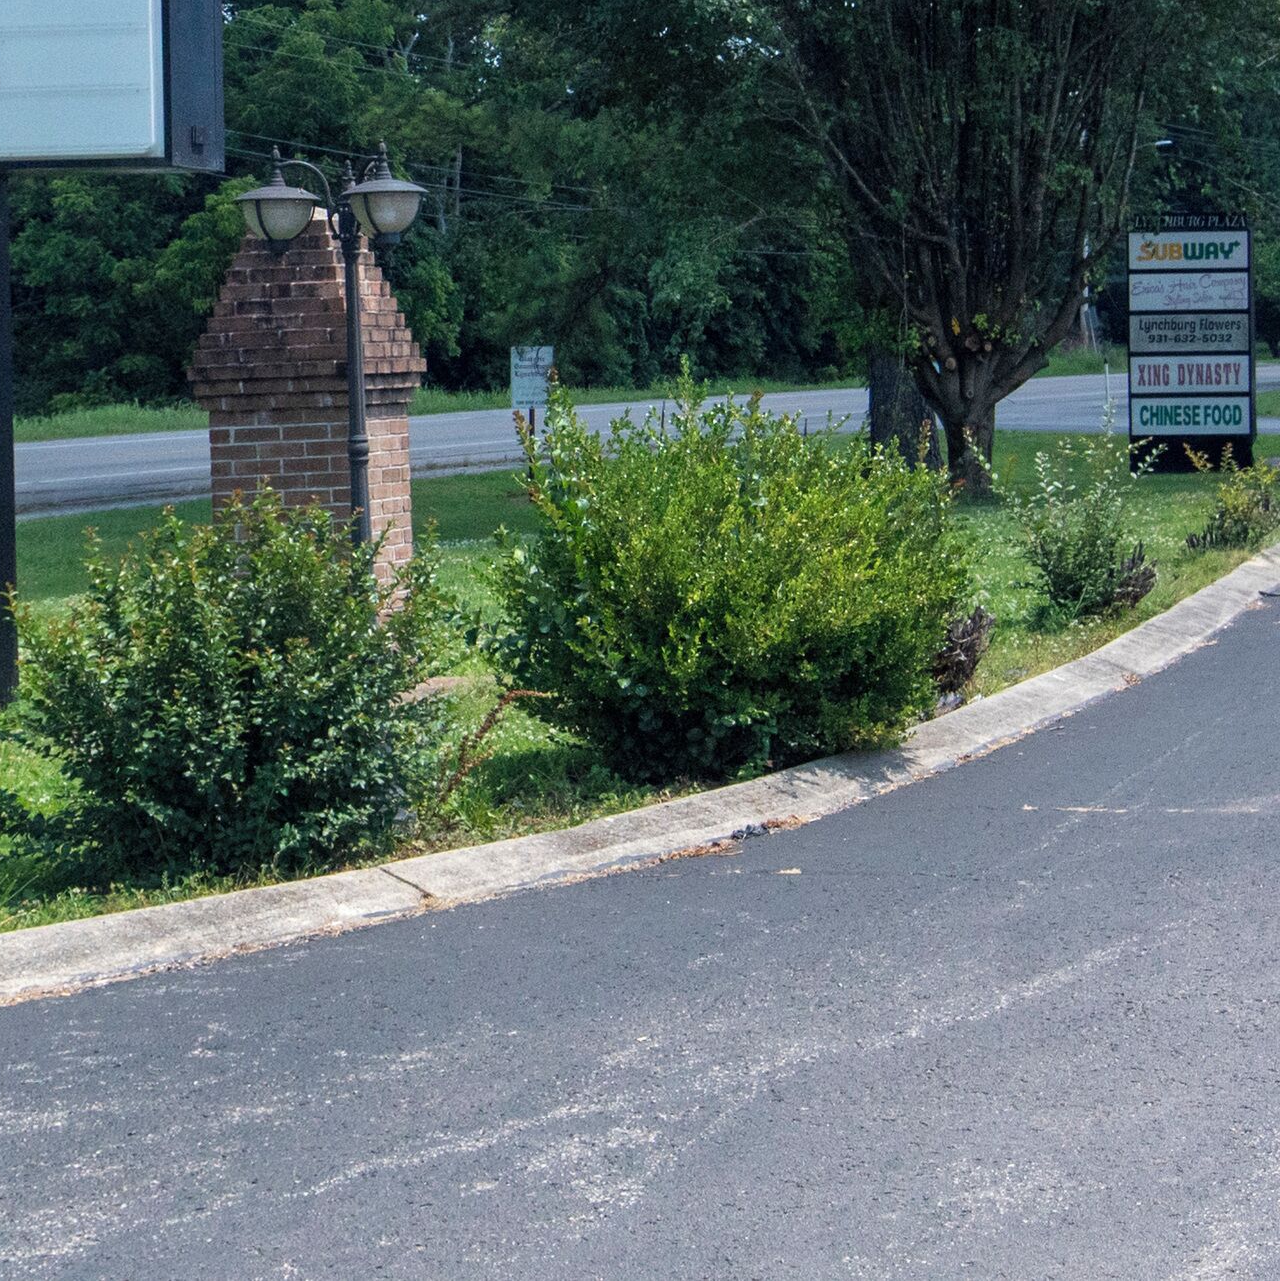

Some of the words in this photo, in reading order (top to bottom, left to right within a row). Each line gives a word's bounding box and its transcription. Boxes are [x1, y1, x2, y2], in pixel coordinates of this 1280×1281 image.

[1135, 215, 1205, 227] LYHBURG
[1207, 214, 1246, 227] PLAZA
[1136, 241, 1240, 261] SUBWAY
[1139, 318, 1196, 333] Lynchburg
[1148, 333, 1233, 344] 931-632-5032
[1137, 364, 1170, 387] XING
[1177, 362, 1241, 386] DYNASTY
[1140, 405, 1201, 427] CHINESE
[1203, 403, 1242, 426] FOOD
